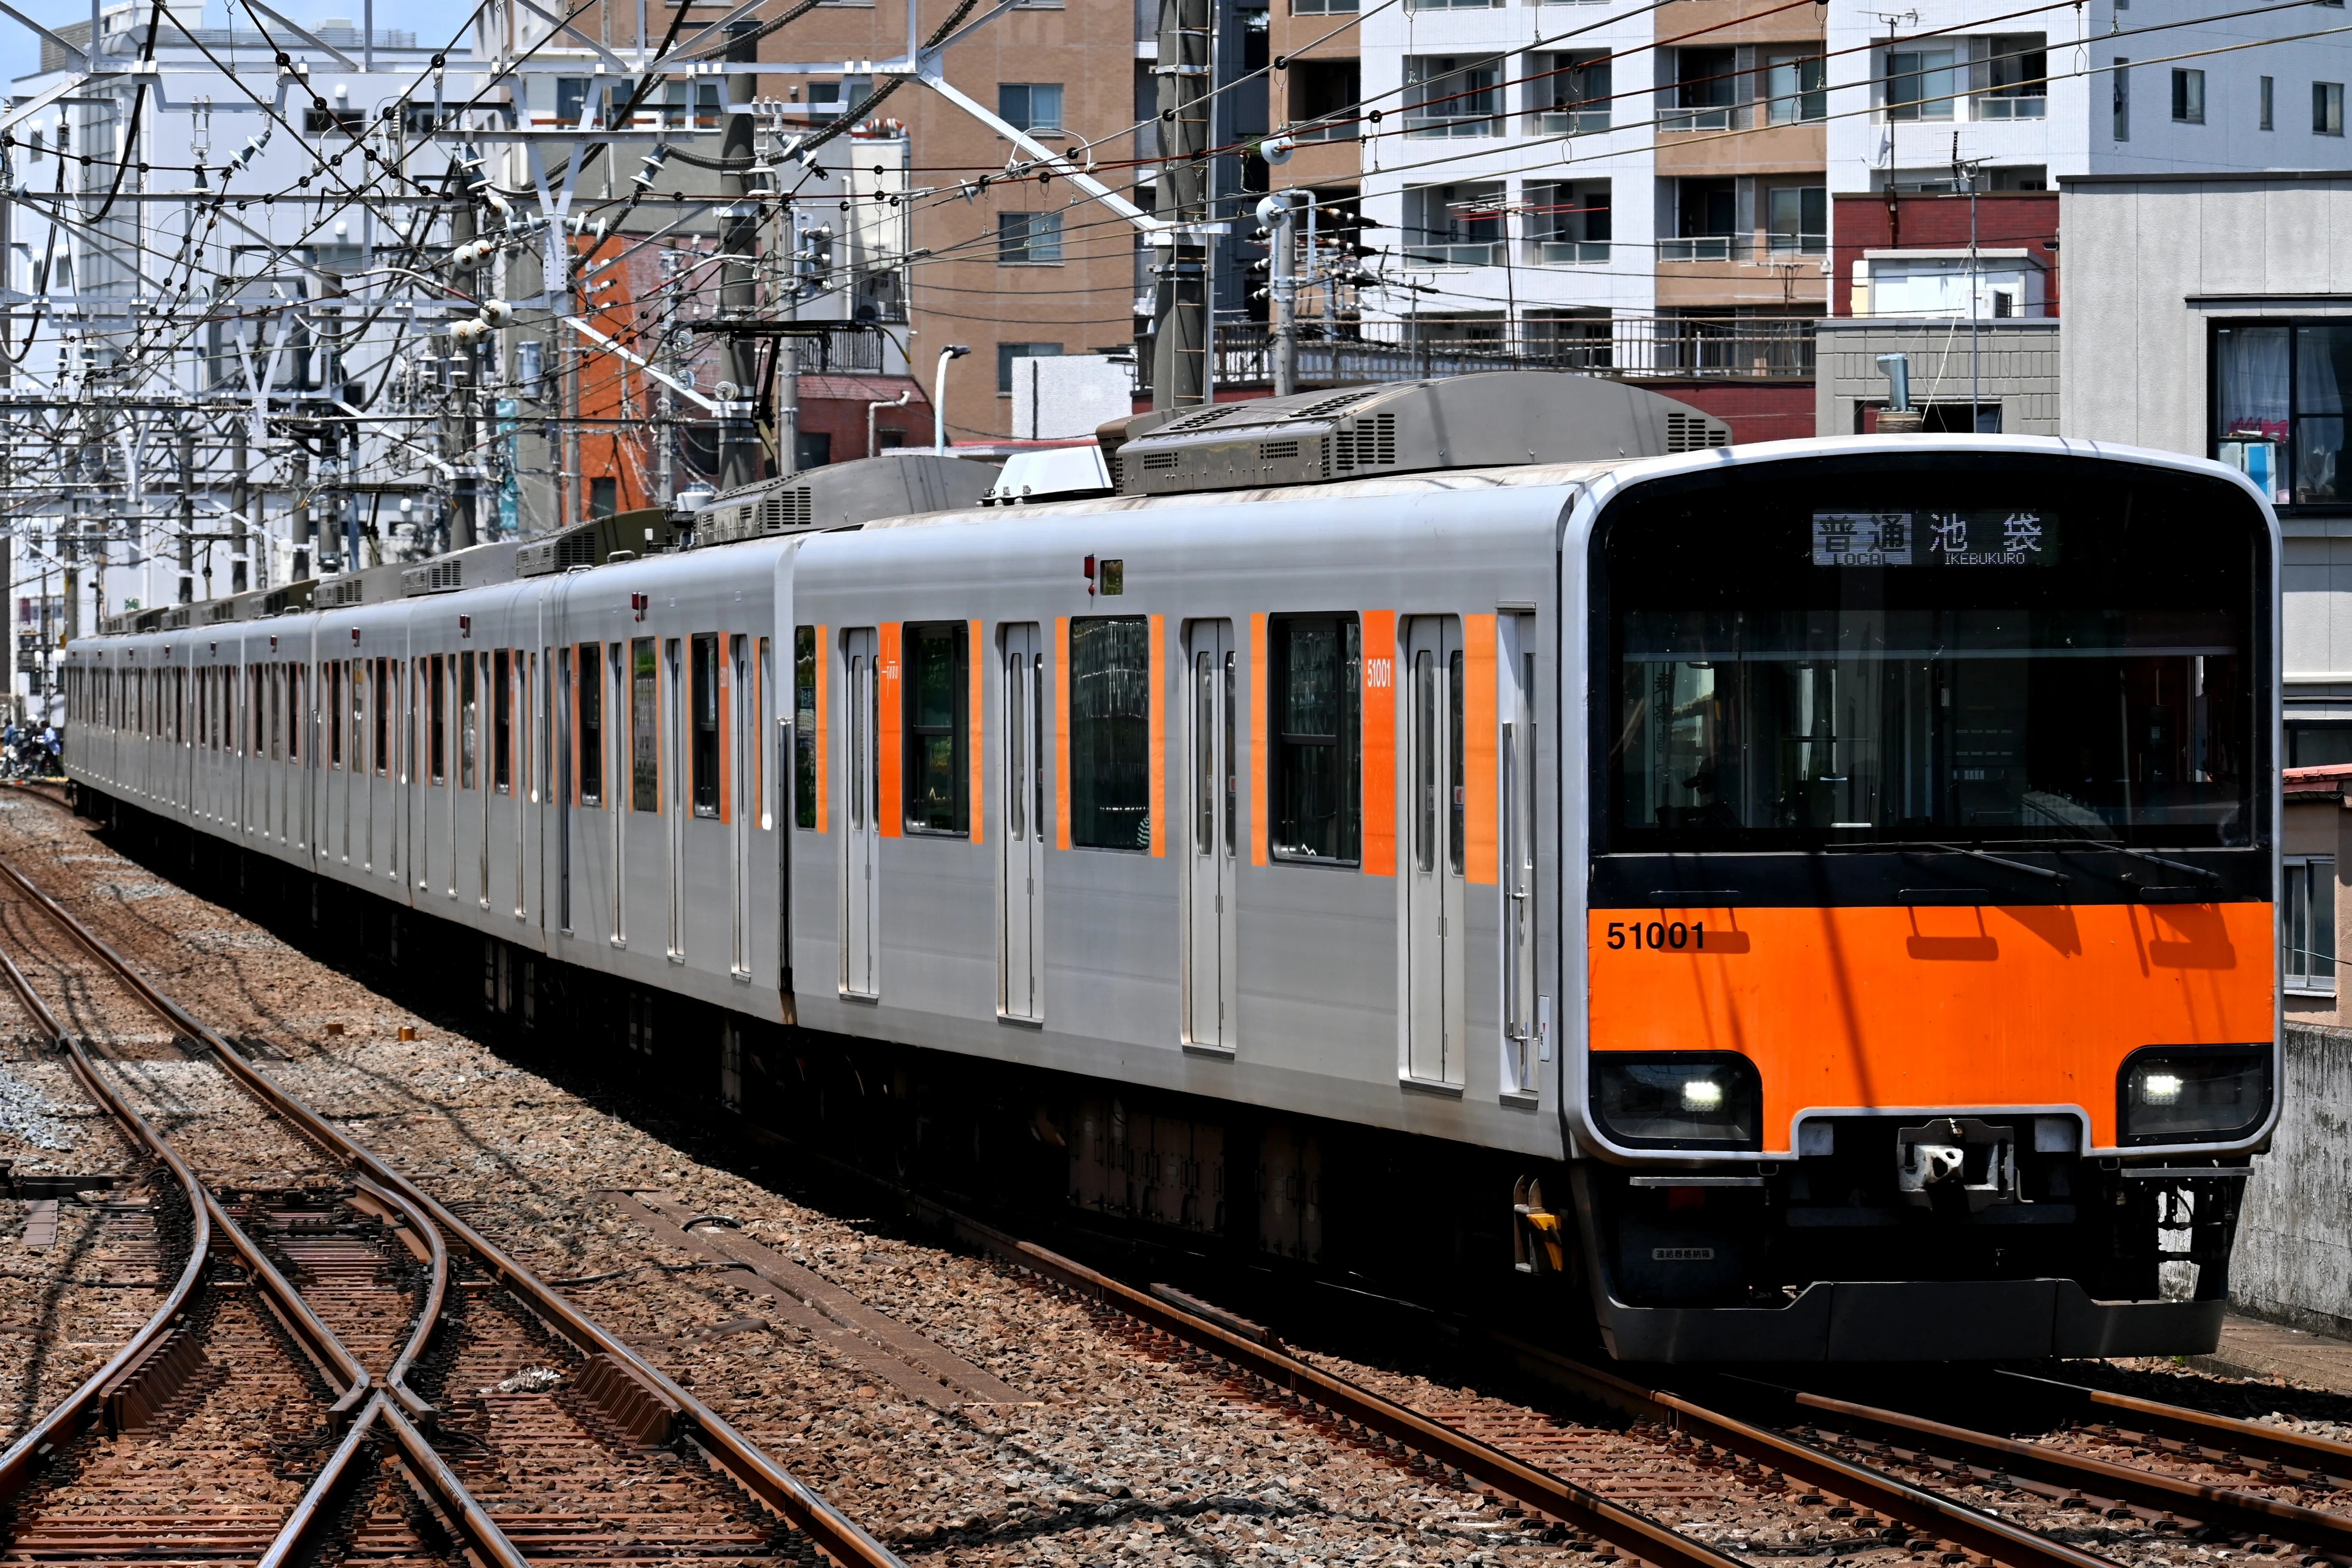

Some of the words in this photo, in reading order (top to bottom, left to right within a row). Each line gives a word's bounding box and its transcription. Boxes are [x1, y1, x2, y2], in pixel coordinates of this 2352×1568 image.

[1818, 514, 1906, 552] 普通
[1929, 513, 2042, 552] 池袋
[1945, 553, 2025, 565] IKEBUKURO
[886, 665, 899, 679] TOBU
[1367, 658, 1390, 688] 51001
[1607, 922, 1703, 949] 51001
[1656, 1250, 1710, 1259] 連結器格納箱
